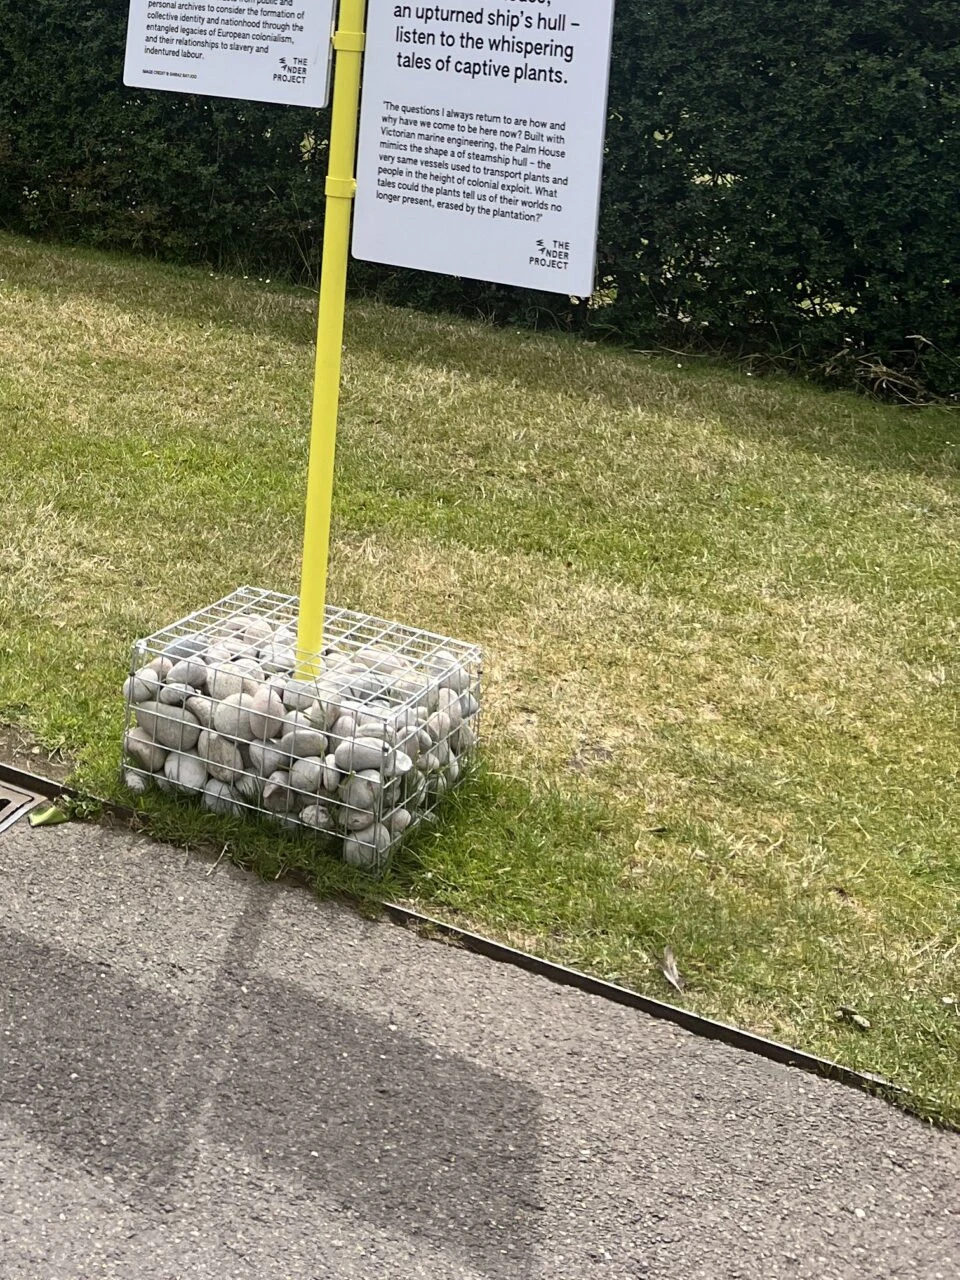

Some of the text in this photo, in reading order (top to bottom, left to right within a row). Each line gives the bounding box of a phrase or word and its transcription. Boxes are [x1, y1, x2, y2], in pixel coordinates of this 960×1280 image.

[146, 10, 304, 32] collective identity and nationhood through the
[147, 0, 304, 19] personal archives to consider the formation of
[393, 5, 411, 18] an
[416, 5, 484, 24] upturned
[537, 12, 566, 31] hull
[144, 46, 180, 57] indentured
[396, 26, 574, 63] listen to the whispering
[397, 52, 568, 84] tales of captive plants.
[381, 114, 564, 144] why have we come to be here now? Built with
[400, 105, 439, 116] questions
[441, 107, 444, 116] I
[446, 108, 473, 121] always
[475, 113, 501, 123] return
[503, 115, 512, 124] to
[513, 118, 527, 126] are
[529, 117, 547, 128] how
[549, 121, 565, 131] and
[379, 141, 407, 151] mimics
[409, 143, 422, 153] the
[424, 145, 448, 157] shape
[456, 149, 465, 158] of
[467, 151, 510, 166] steamship
[511, 155, 527, 166] hull
[537, 159, 551, 170] the
[380, 126, 415, 139] Victorian
[417, 133, 445, 143] marine
[499, 141, 513, 151] the
[515, 142, 536, 154] Palm
[538, 145, 565, 158] House
[377, 166, 403, 177] people
[414, 170, 427, 180] the
[429, 171, 455, 185] height
[456, 175, 465, 185] of
[466, 178, 499, 189] colonial
[534, 185, 557, 198] What
[378, 154, 568, 185] very same vessels used to transport plants and
[376, 190, 401, 203] longer
[436, 201, 464, 211] erased
[465, 203, 475, 215] by
[477, 205, 491, 215] the
[377, 178, 562, 212] tales could the plants tell us of their worlds no
[552, 240, 570, 250] THE
[529, 256, 569, 270] PROJECT
